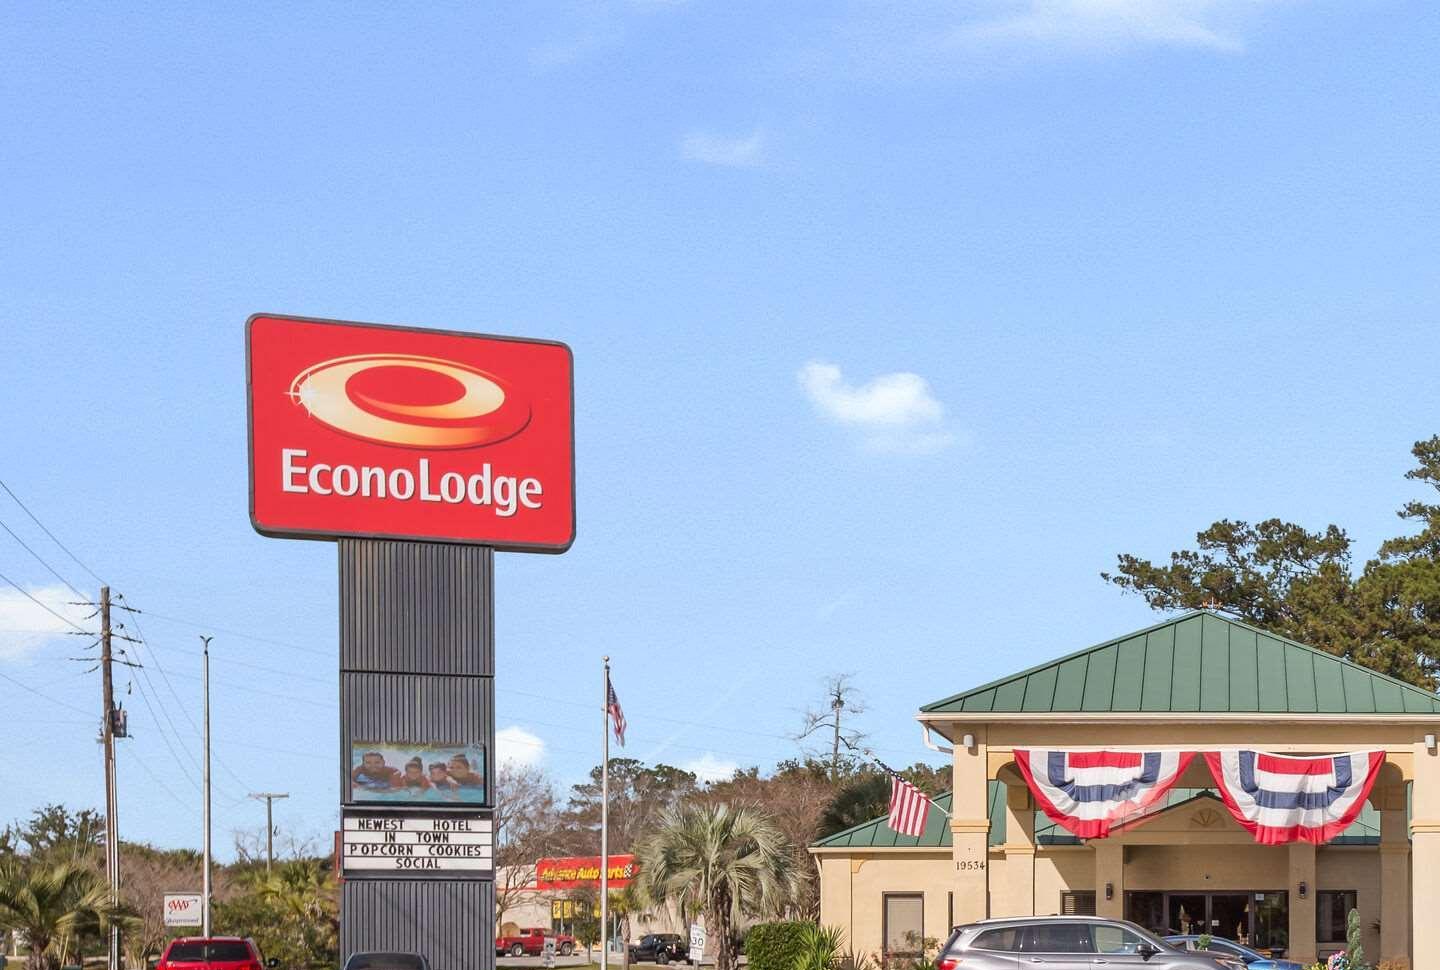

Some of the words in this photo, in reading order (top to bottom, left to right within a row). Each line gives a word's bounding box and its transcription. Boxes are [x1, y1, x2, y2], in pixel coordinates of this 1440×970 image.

[281, 448, 543, 517] EconoLodge
[358, 819, 405, 830] NEWEST
[433, 820, 472, 831] HOTEL
[385, 832, 396, 842] IN
[416, 832, 449, 843] TOWN
[350, 844, 413, 855] POPCORN
[428, 845, 481, 856] COOKIES
[396, 858, 440, 869] SOCIAL
[956, 861, 985, 870] 19534
[577, 867, 600, 880] Auto
[599, 867, 625, 880] arts
[691, 937, 704, 946] 30
